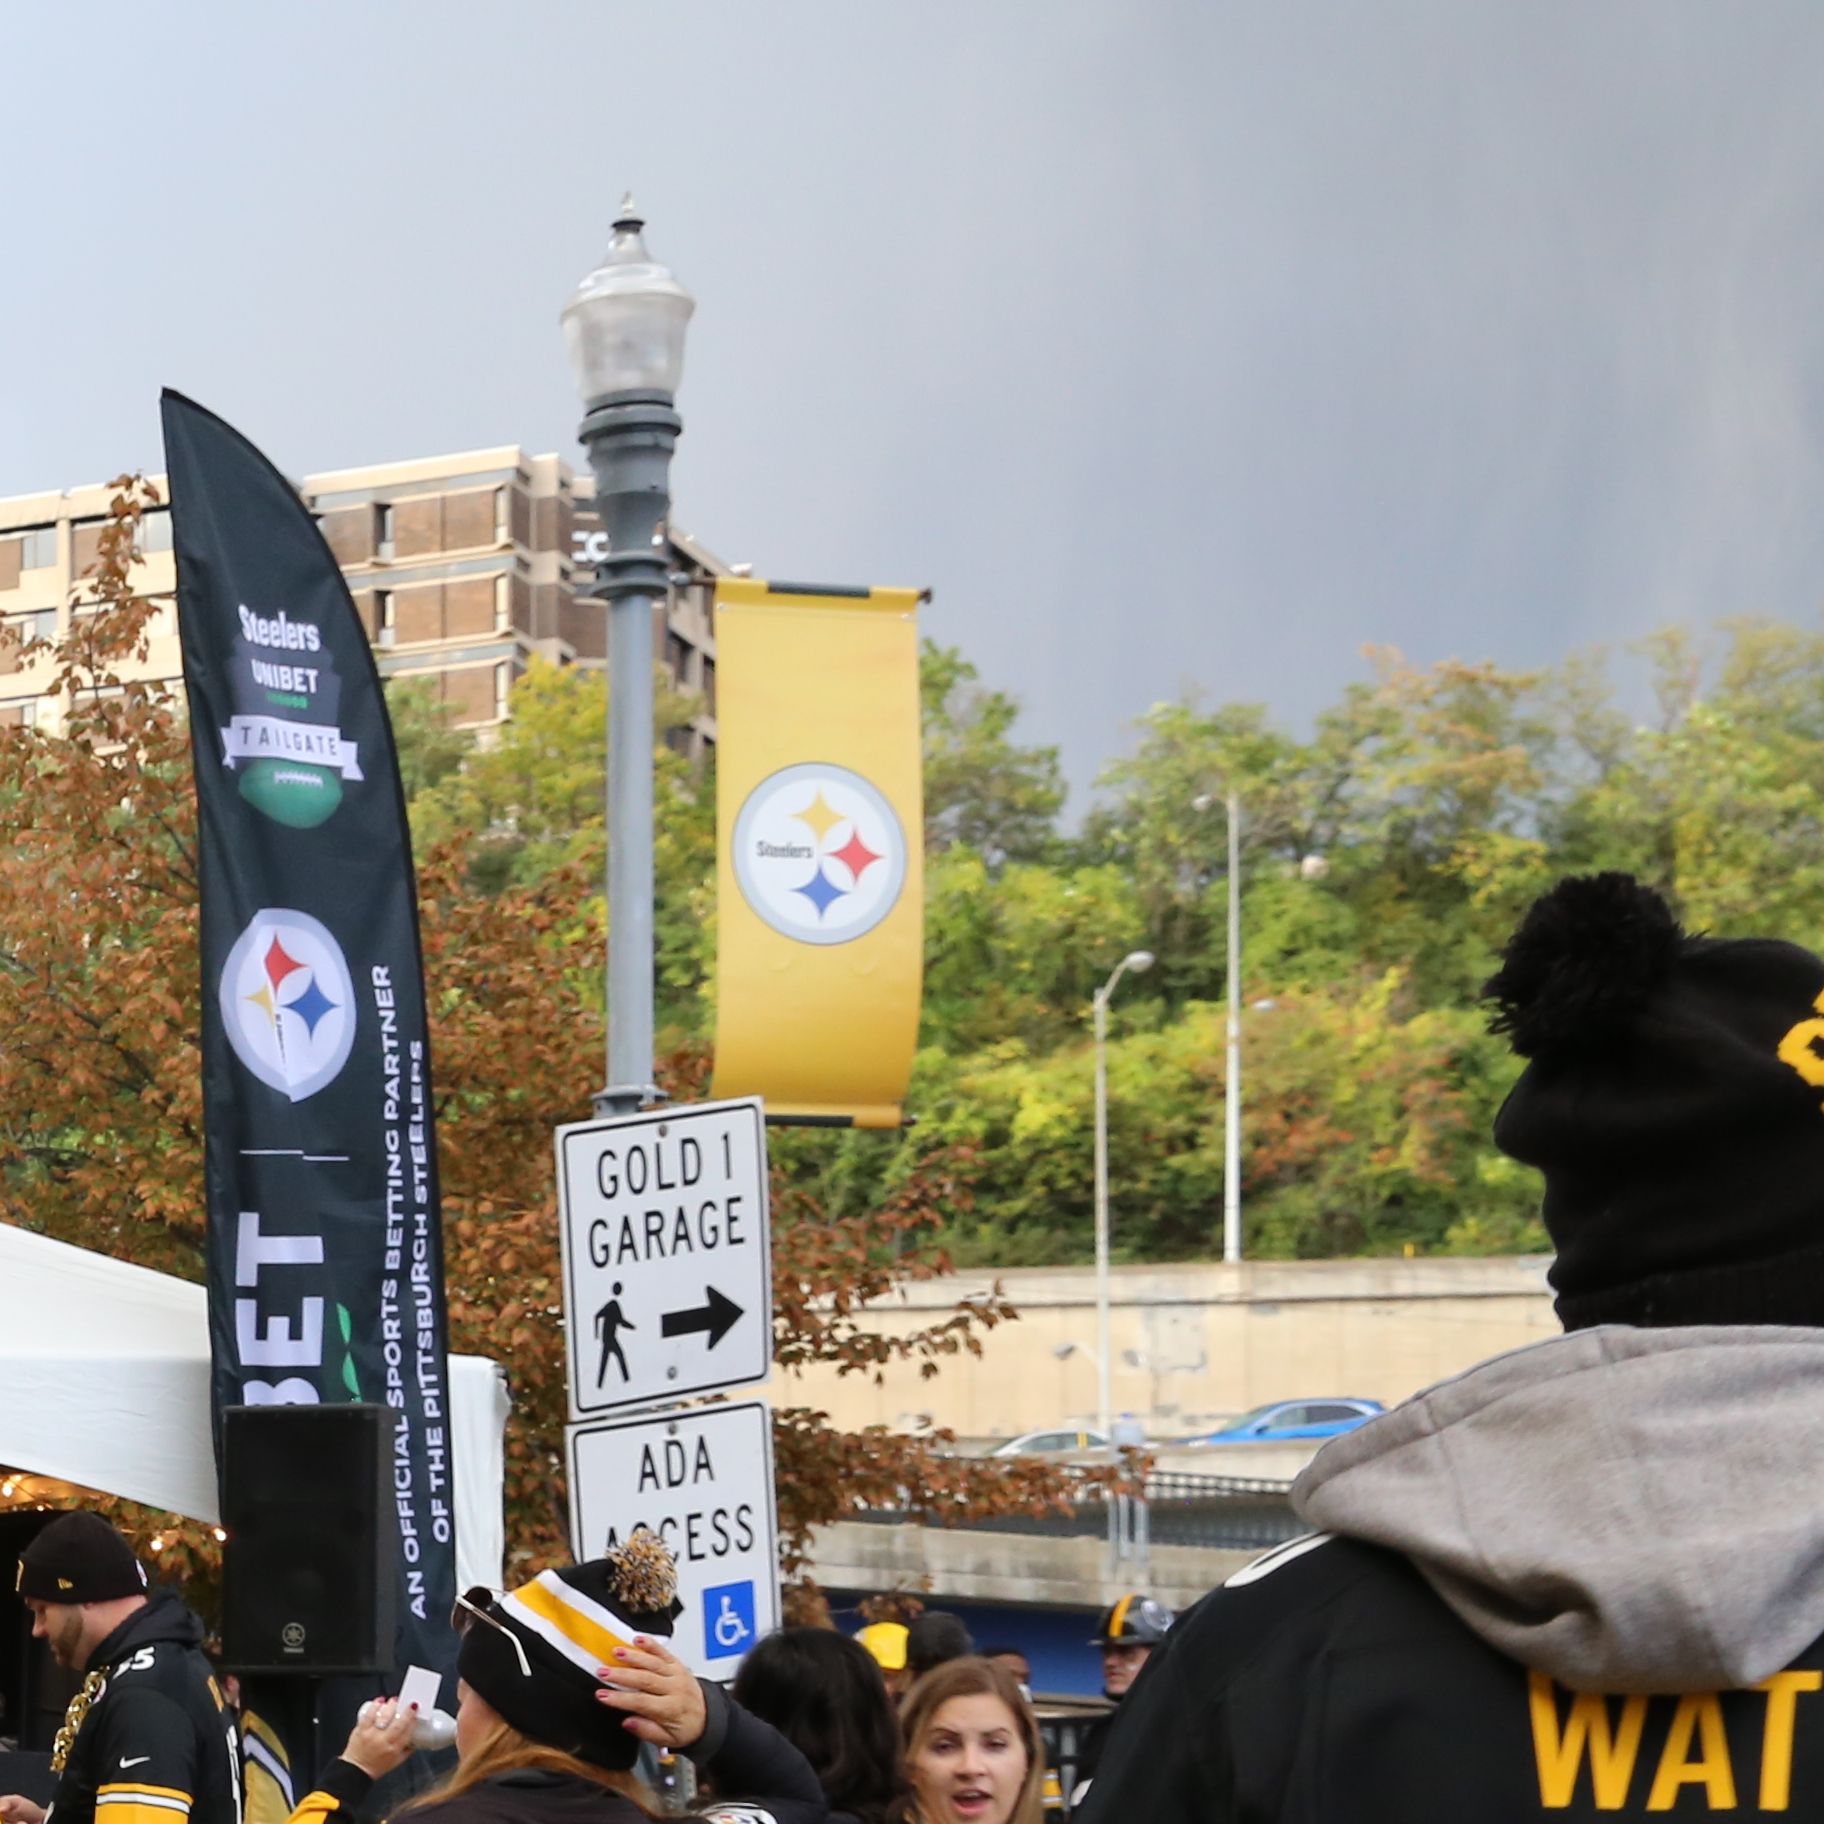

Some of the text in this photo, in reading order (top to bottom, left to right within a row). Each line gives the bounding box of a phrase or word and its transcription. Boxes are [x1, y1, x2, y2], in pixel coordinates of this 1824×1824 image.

[238, 604, 320, 652] Steelers
[251, 659, 318, 693] UNIBET
[241, 726, 337, 756] TAILGATE
[756, 840, 813, 860] Steelers
[598, 1132, 733, 1199] GOLD 1
[589, 1196, 747, 1269] GARAGE
[372, 965, 426, 1620] AN OFFICIAL SPORTS BETTING PARTNER
[410, 1213, 441, 1418] PITTSBURGH
[426, 1426, 445, 1492] THE
[638, 1435, 715, 1493] ADA
[431, 1499, 450, 1543] OF
[606, 1504, 755, 1563] ACESS
[1527, 1669, 1823, 1812] WAT
